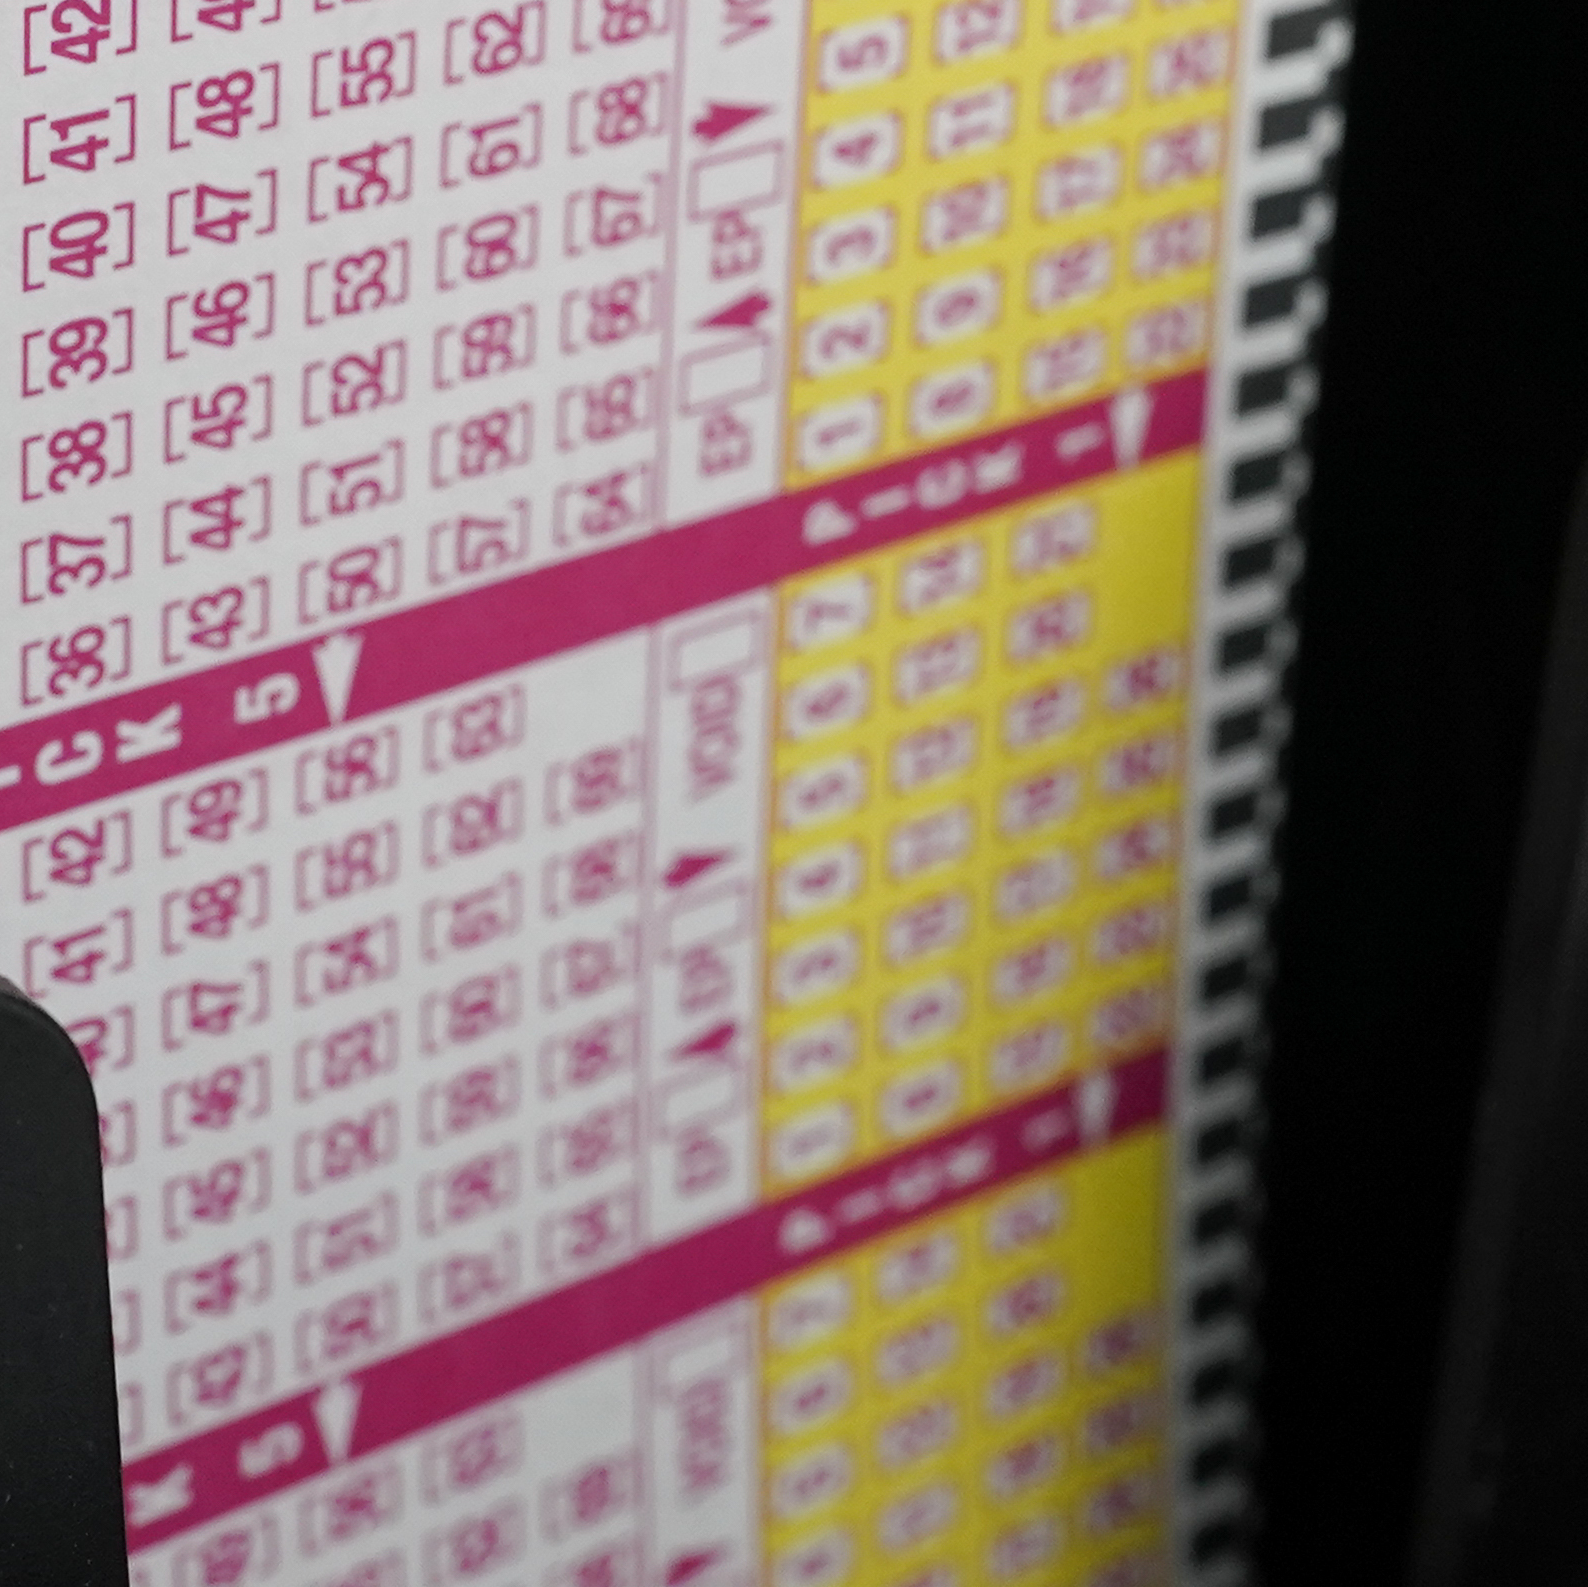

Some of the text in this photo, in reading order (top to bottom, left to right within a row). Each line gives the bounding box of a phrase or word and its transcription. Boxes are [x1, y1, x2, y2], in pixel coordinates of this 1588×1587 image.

[195, 70, 255, 138] 48
[50, 110, 109, 171] 41
[49, 211, 109, 278] 40
[194, 184, 250, 244] 47
[192, 281, 250, 347] 46
[49, 317, 108, 388] 39
[190, 385, 248, 449] 45
[48, 421, 107, 492] 38
[189, 486, 243, 549] 44
[48, 533, 106, 595] 37
[189, 586, 244, 648] 43
[48, 626, 105, 695] 36
[233, 672, 301, 724] 5
[49, 821, 105, 884] 42
[51, 927, 104, 984] 41
